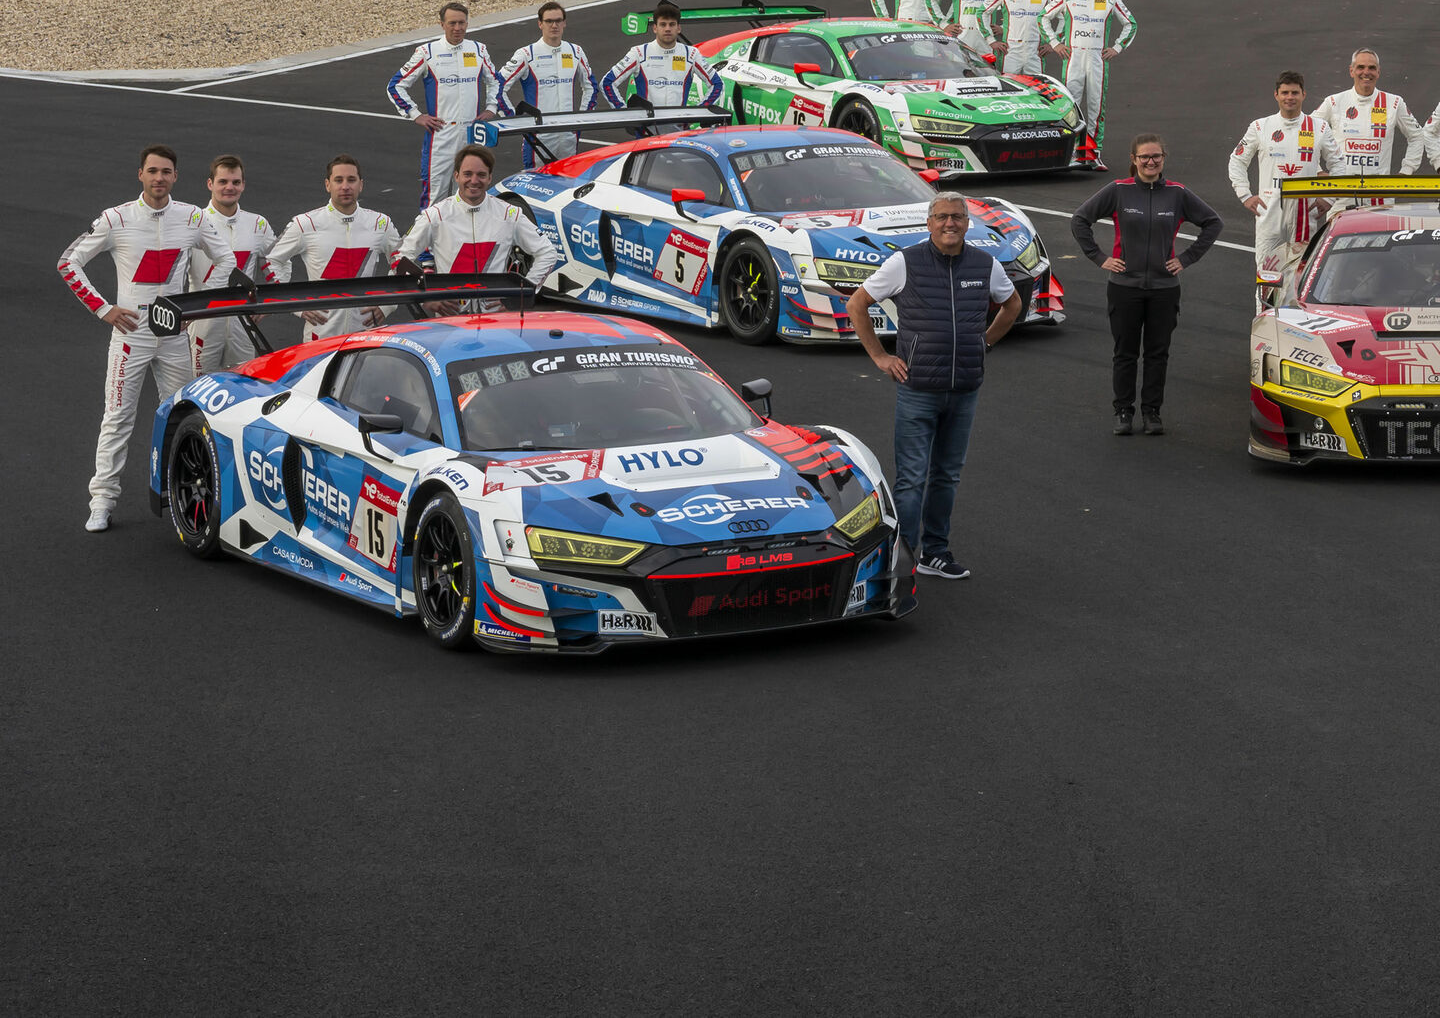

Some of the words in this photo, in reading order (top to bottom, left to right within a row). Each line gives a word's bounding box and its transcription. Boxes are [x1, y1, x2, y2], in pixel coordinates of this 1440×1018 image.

[902, 33, 922, 41] GRAN
[440, 77, 477, 85] SCHERER
[539, 78, 573, 86] SCHERER
[649, 78, 684, 87] SCHERER
[903, 84, 931, 93] 16
[931, 109, 973, 120] Travaglini
[978, 103, 1050, 114] SCHERER
[813, 147, 844, 157] GRAN
[846, 147, 891, 157] TURISMO
[1347, 142, 1379, 151] Veedol
[1012, 150, 1036, 160] Audi
[1038, 148, 1065, 159] Sport
[1346, 155, 1374, 166] TECE
[524, 184, 554, 195] WIZARD
[808, 217, 833, 228] 5
[570, 225, 654, 266] SCHERER
[836, 248, 879, 262] HYLO
[674, 250, 685, 283] 5
[576, 352, 621, 366] GRAN
[624, 352, 698, 367] TURISMO
[1289, 347, 1322, 365] TECE
[118, 356, 128, 379] Audi
[116, 380, 126, 407] Sport
[618, 448, 704, 473] HYLO
[425, 465, 470, 491] ALKEN
[517, 464, 571, 484] 15
[249, 450, 351, 521] SCHERER
[307, 502, 318, 516] Autos
[656, 497, 810, 523] SCHERER
[367, 508, 385, 559] 15
[272, 546, 290, 561] CASA
[295, 556, 314, 570] MODA
[760, 552, 793, 563] LMS
[345, 572, 357, 588] Audi
[357, 578, 373, 593] Sport
[719, 590, 768, 610] Audi
[775, 583, 832, 604] Sport
[487, 627, 524, 638] MICHELIN
